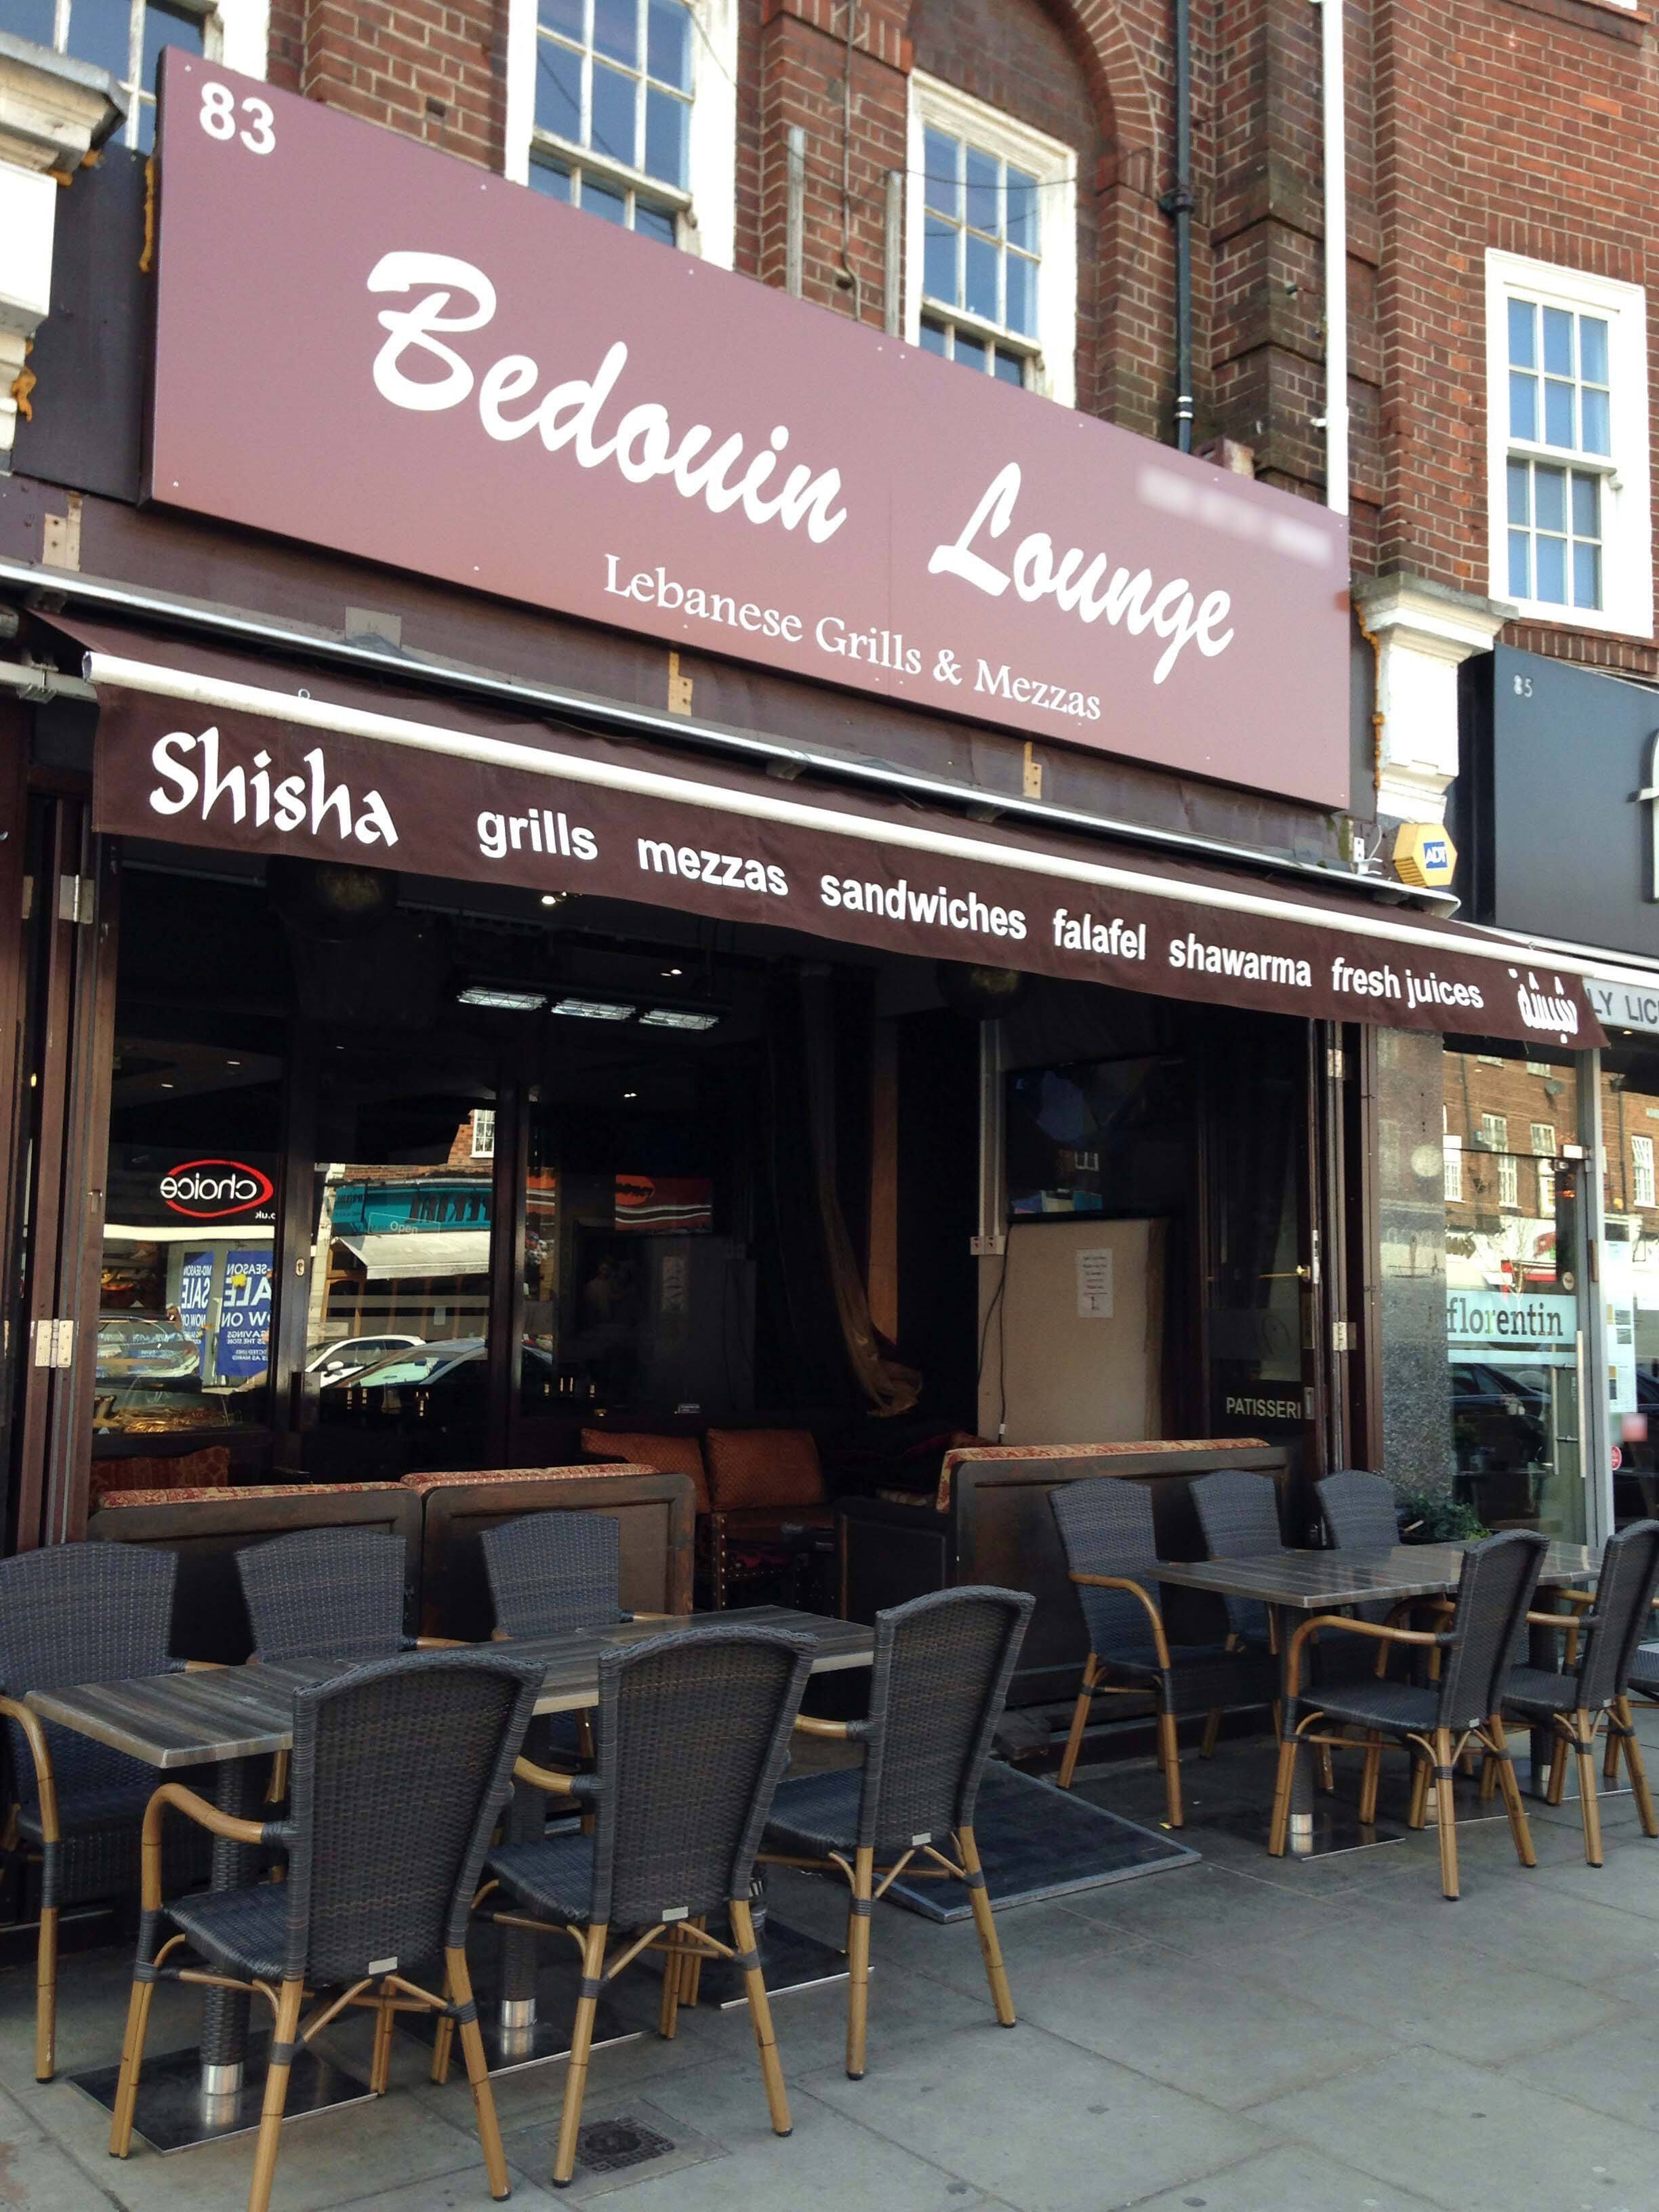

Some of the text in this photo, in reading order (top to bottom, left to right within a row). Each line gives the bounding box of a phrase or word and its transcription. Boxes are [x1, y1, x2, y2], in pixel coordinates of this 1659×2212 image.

[199, 82, 276, 155] 83
[367, 251, 1234, 685] Bedouin Lounge
[604, 554, 1101, 720] Lebanese Grills & Mezzas
[1514, 674, 1533, 698] 85
[149, 726, 1484, 1009] Shisha grills mezzas sandwiches falafel shawarma fresh juices
[1425, 846, 1447, 863] ADT
[1624, 995, 1659, 1025] LIC
[390, 1221, 418, 1234] Open
[1447, 1297, 1563, 1336] florentin
